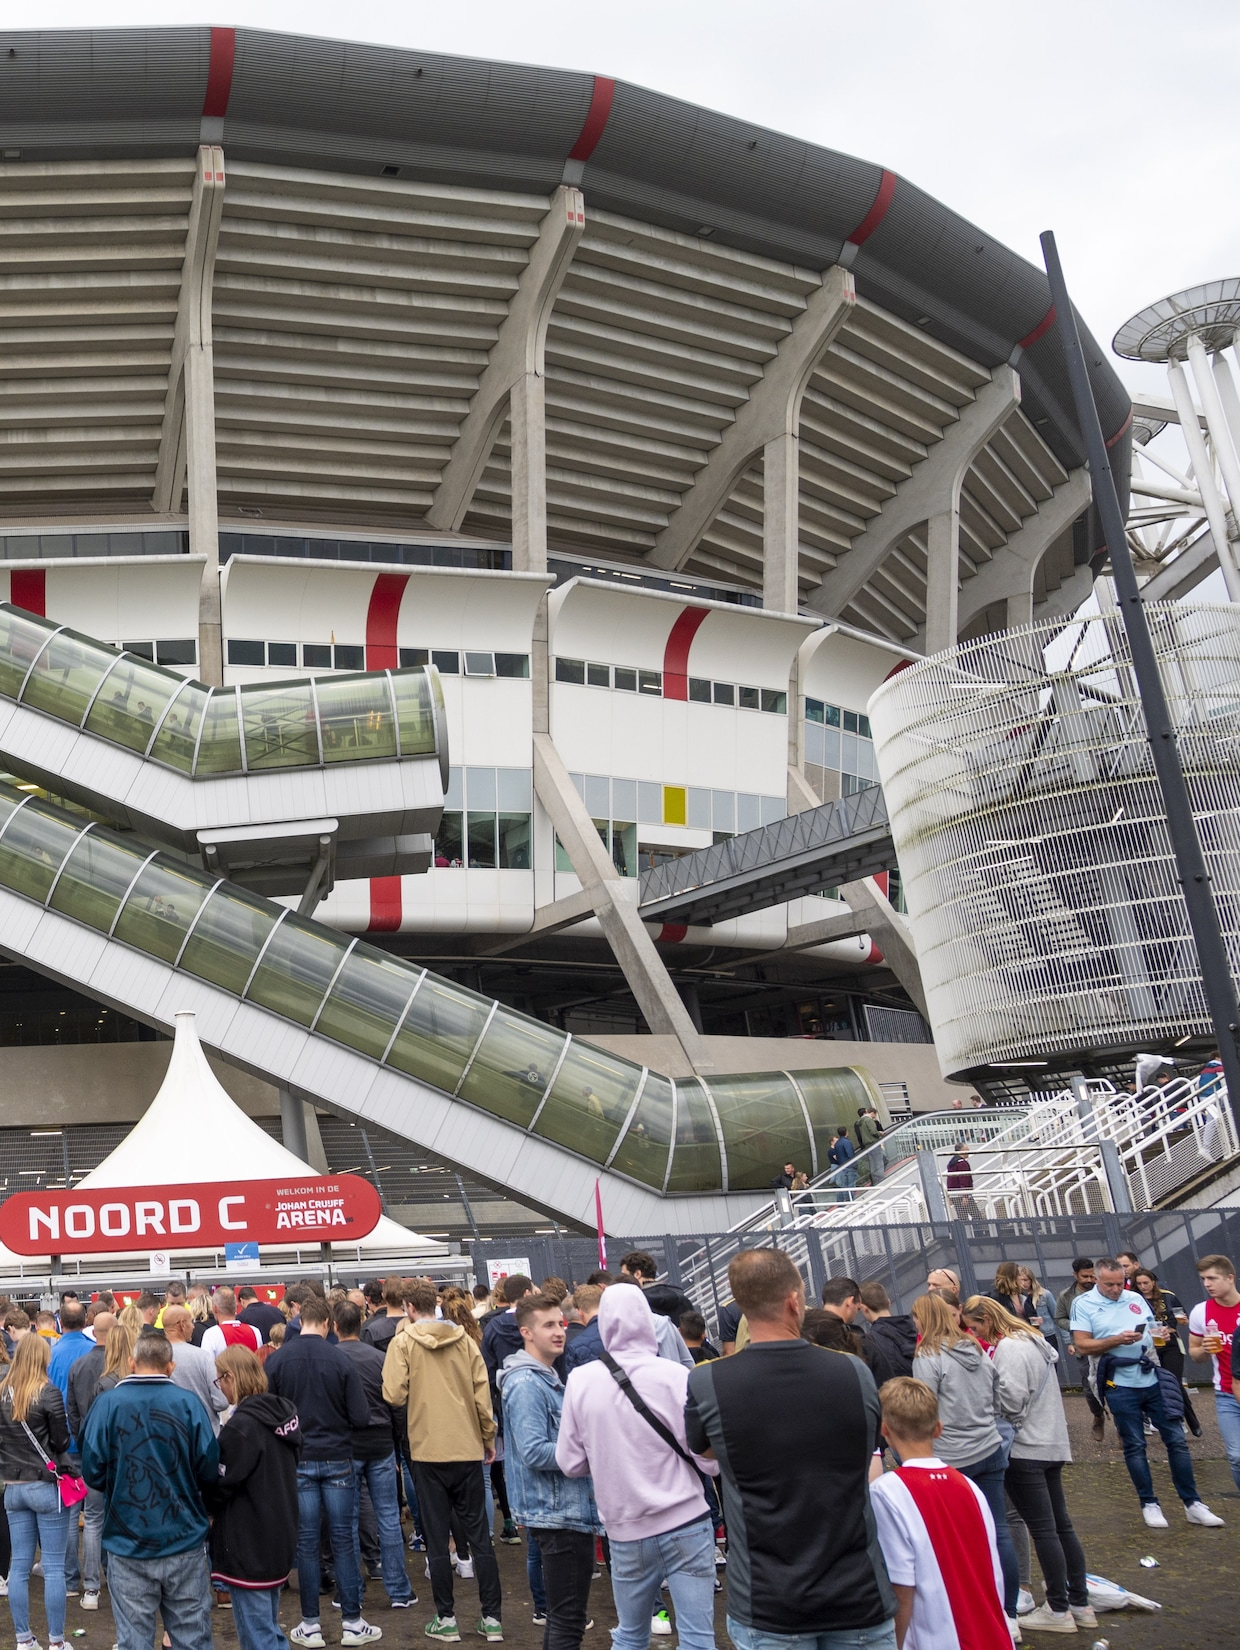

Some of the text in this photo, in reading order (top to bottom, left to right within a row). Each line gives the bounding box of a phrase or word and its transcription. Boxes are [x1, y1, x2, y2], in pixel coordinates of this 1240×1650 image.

[276, 1185, 340, 1197] WELKOM IN DE
[275, 1202, 307, 1211] JOHAN
[28, 1195, 248, 1241] NOORD C
[276, 1208, 347, 1230] ARENA
